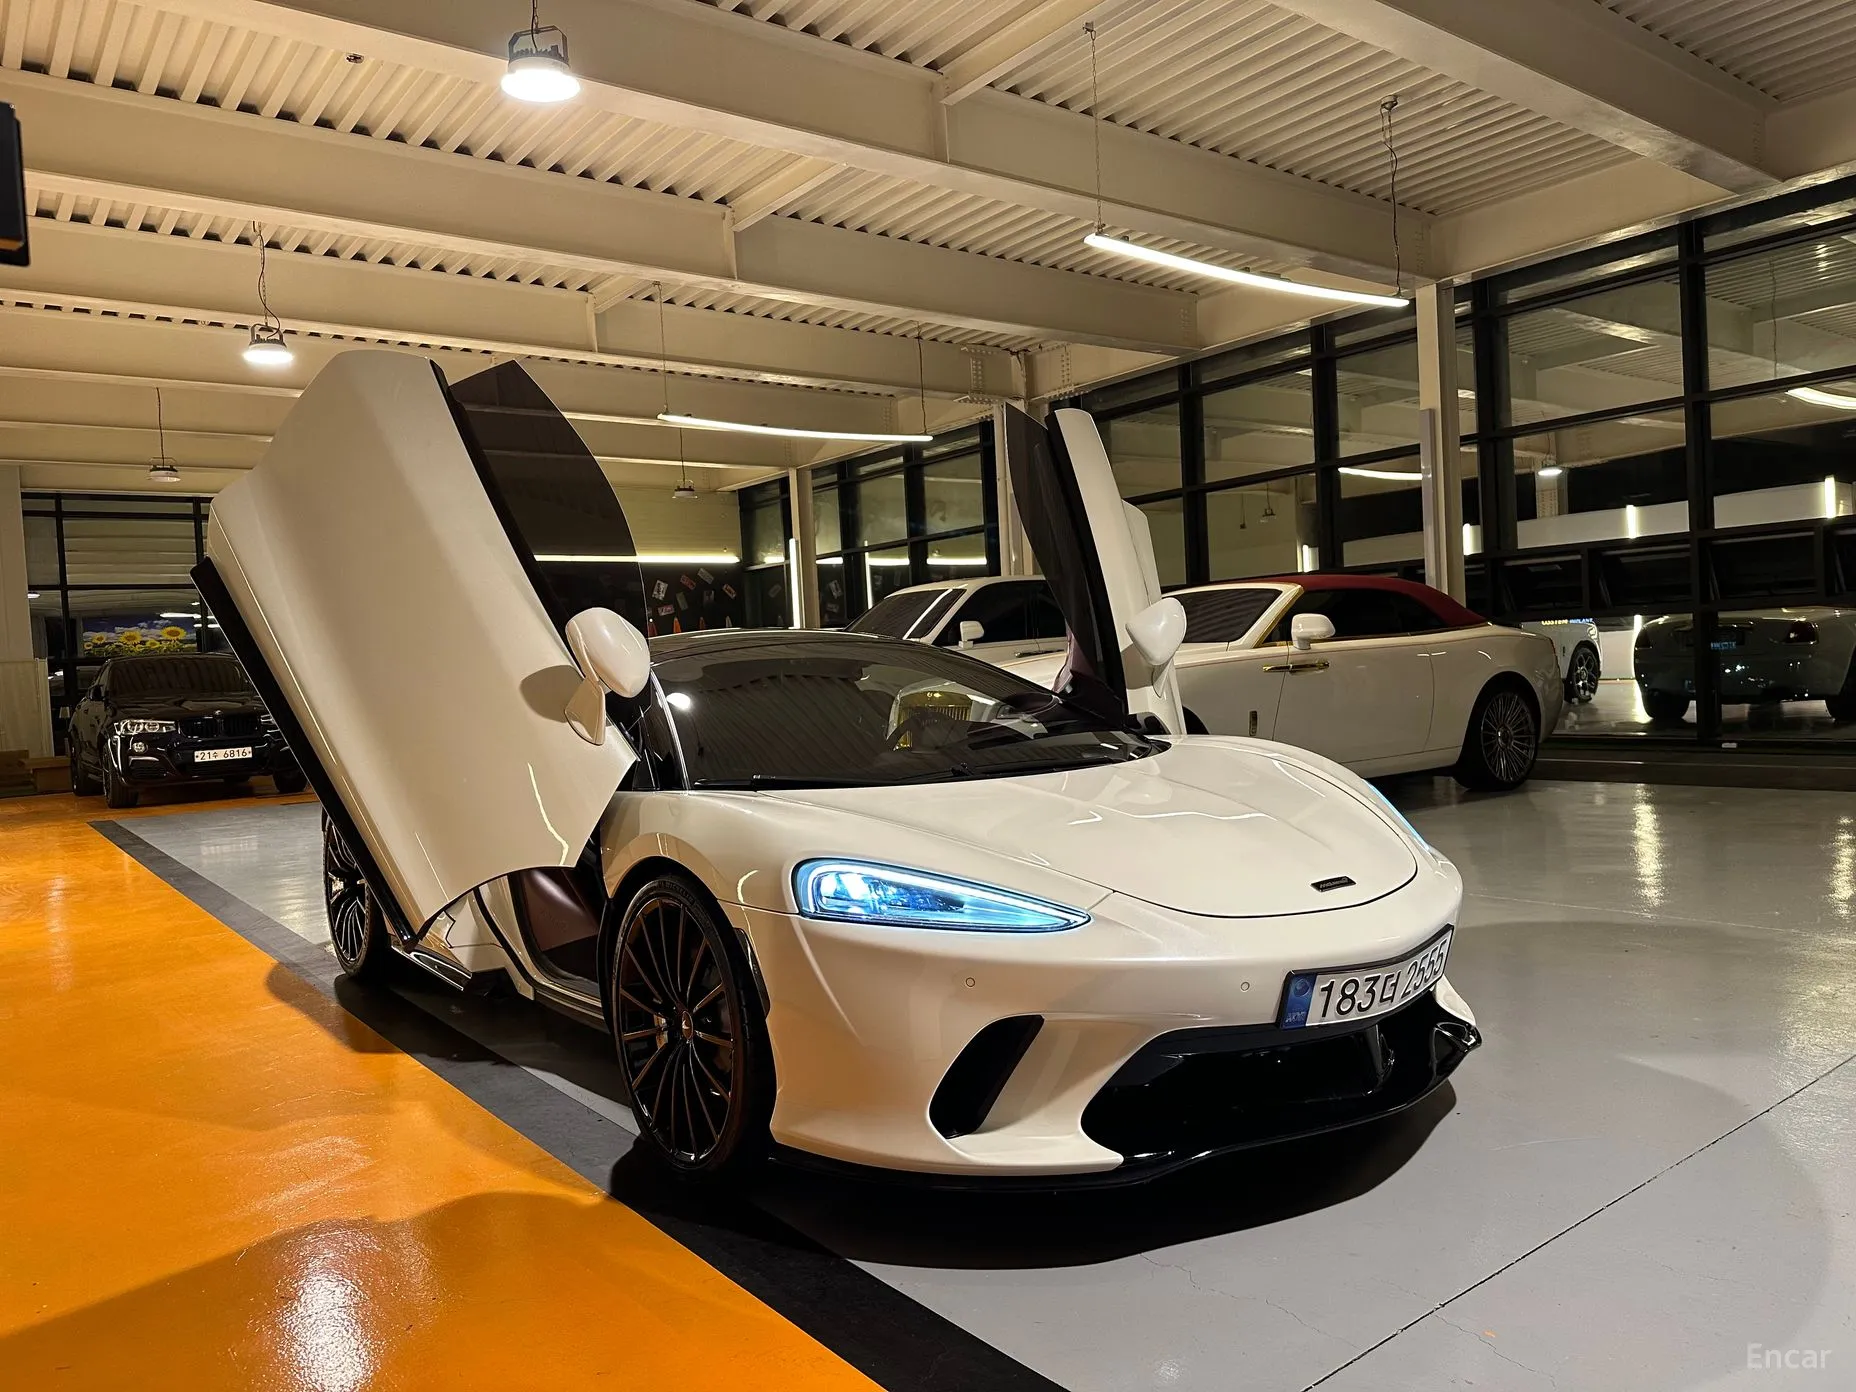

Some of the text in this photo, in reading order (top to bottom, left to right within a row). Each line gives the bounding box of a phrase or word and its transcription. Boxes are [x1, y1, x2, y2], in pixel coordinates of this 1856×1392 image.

[223, 748, 248, 759] 6816
[1319, 938, 1448, 1018] 183더 2555
